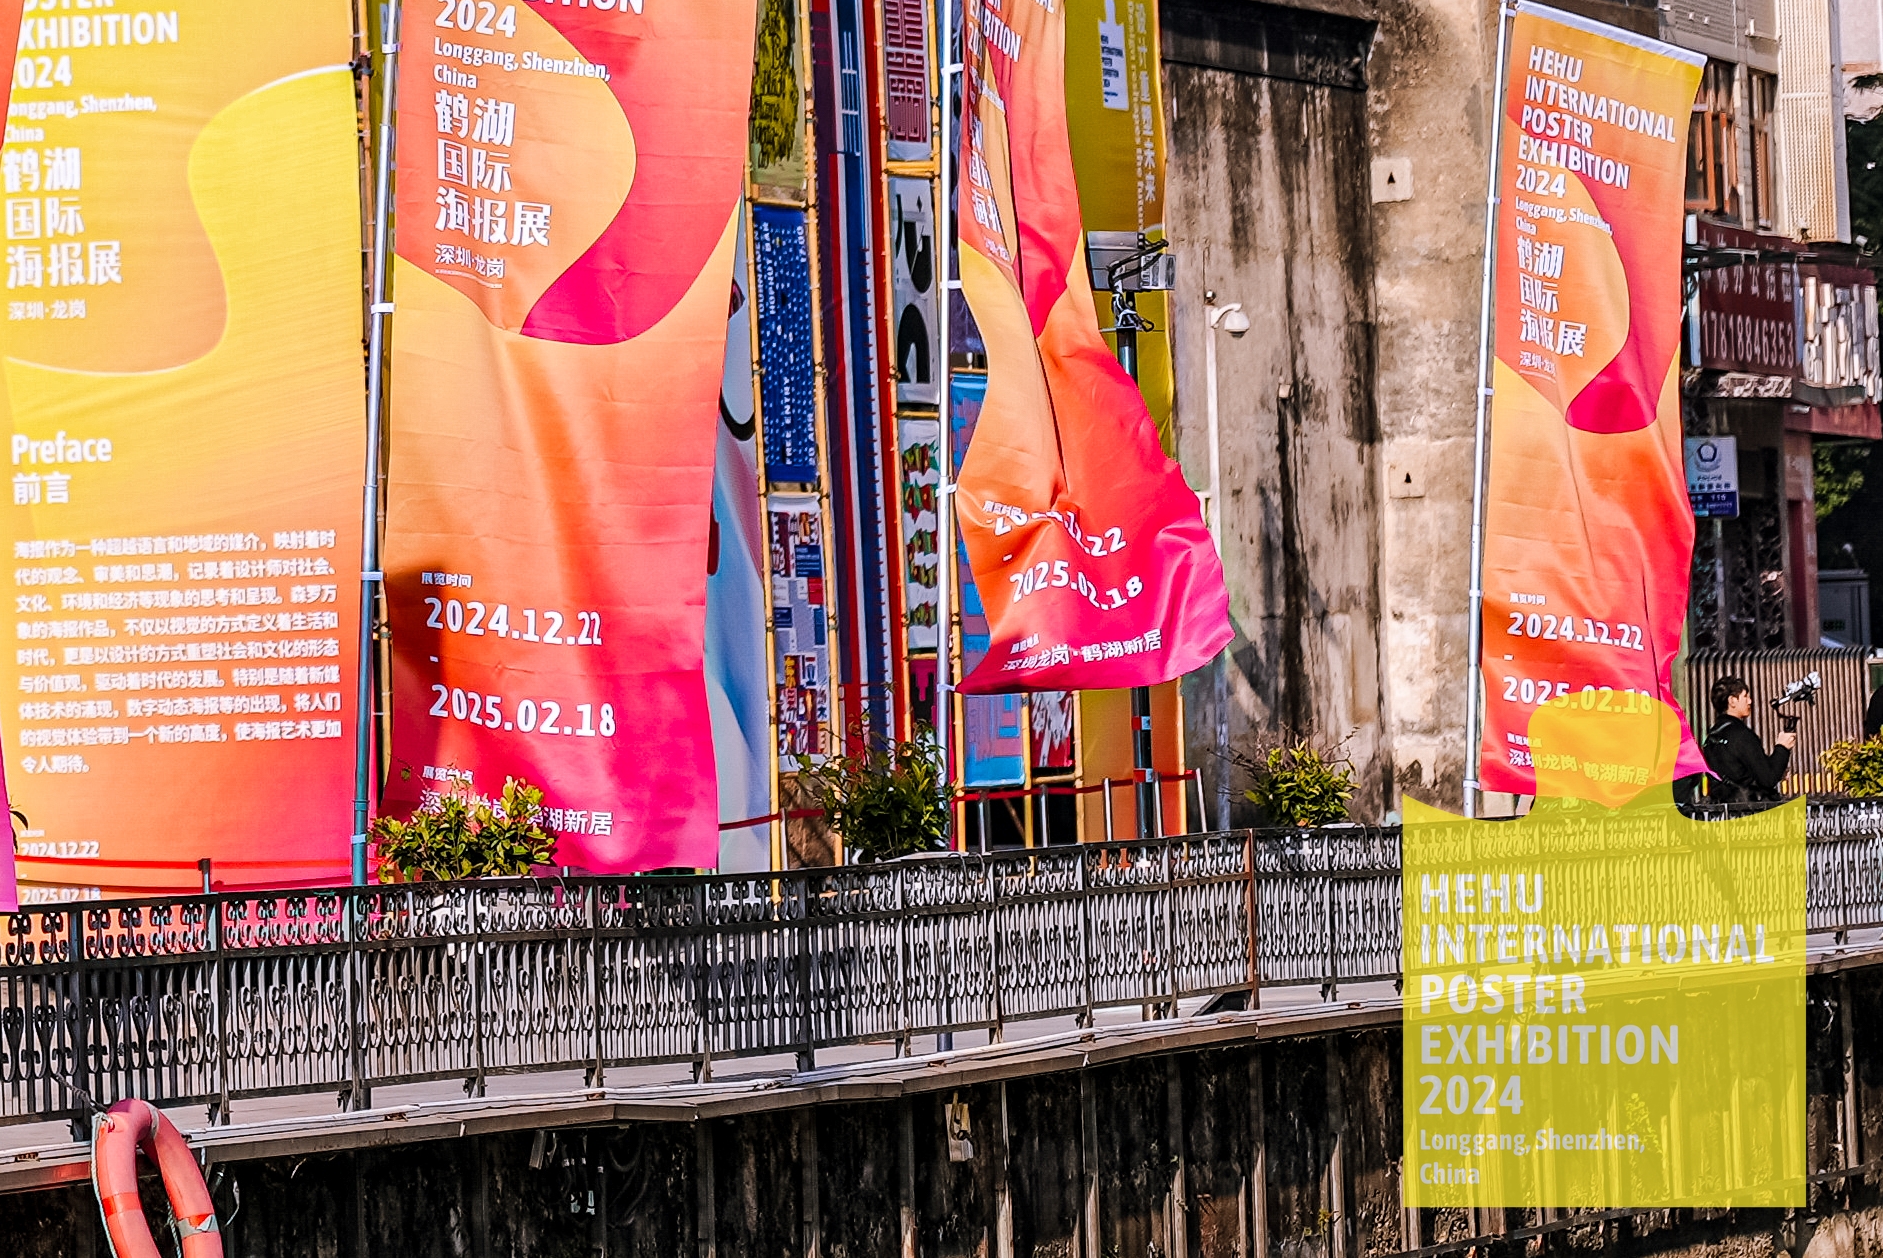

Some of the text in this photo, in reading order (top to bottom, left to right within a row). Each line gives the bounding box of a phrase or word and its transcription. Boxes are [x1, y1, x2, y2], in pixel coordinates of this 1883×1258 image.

[17, 11, 179, 50] XHIBITION
[11, 55, 72, 89] 024
[434, 38, 611, 82] Longgang, Shenzhen,
[434, 65, 477, 89] China
[1528, 45, 1583, 83] HEHU
[8, 93, 157, 120] onggang, Shenzhen,
[434, 91, 516, 147] 鹤湖
[1521, 104, 1593, 148] POSTER
[1525, 75, 1675, 142] INTERNATIONAL
[3, 147, 82, 192] 鹤湖
[436, 142, 512, 193] 国际
[1516, 164, 1566, 199] 2024
[1518, 135, 1631, 190] EXHIBITION
[5, 197, 85, 240] 国际
[435, 186, 552, 247] 海报展
[1516, 196, 1567, 223] Longgang,
[1516, 216, 1537, 235] China
[6, 240, 122, 289] 海报展
[1517, 235, 1565, 279] 鹤湖
[1519, 272, 1559, 314] 国际
[1520, 308, 1588, 357] 海报展
[783, 376, 793, 465] FREE ENTRY
[11, 431, 112, 465] Preface
[13, 472, 72, 505] 前言
[421, 572, 472, 588] 展览时间
[1009, 560, 1144, 610] 2025.02.18
[424, 597, 602, 645] 2024.12.22
[1507, 612, 1645, 651] 2024.12.22
[429, 684, 616, 737] 2025.02.18
[1503, 676, 1653, 715] 2025.02.18
